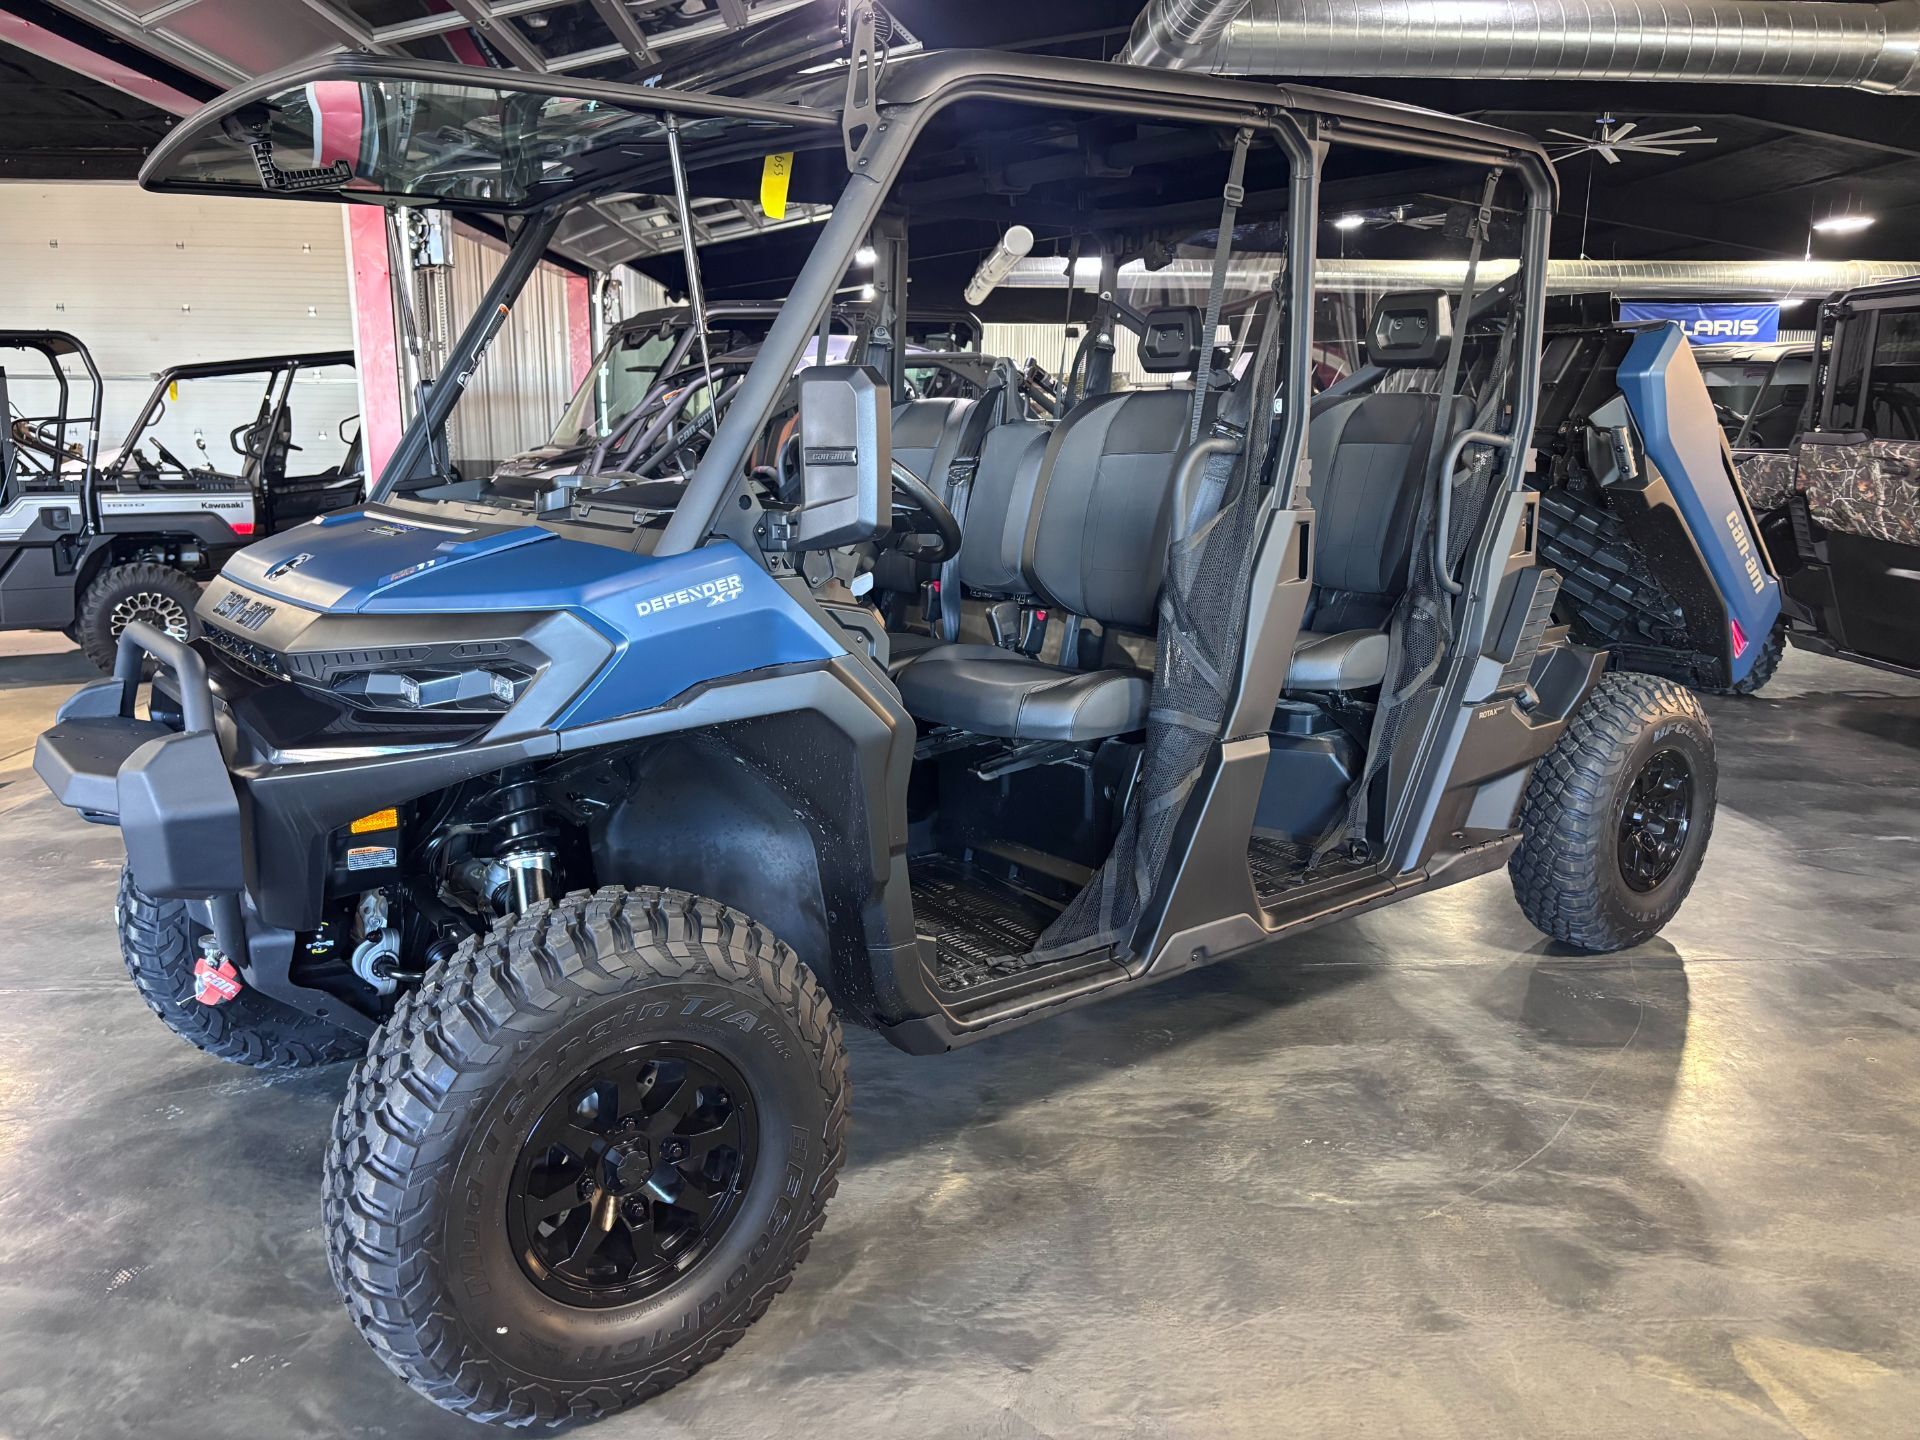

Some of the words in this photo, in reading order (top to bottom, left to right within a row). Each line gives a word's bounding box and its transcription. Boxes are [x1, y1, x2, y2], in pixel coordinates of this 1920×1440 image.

[1668, 319, 1760, 336] LARIS
[201, 501, 245, 509] Kawasaki
[1726, 510, 1765, 595] can-am
[635, 575, 742, 617] DEFENDER
[706, 587, 743, 608] XT
[212, 591, 276, 632] can-am
[1478, 708, 1498, 720] ROTAX
[680, 994, 760, 1034] T/A
